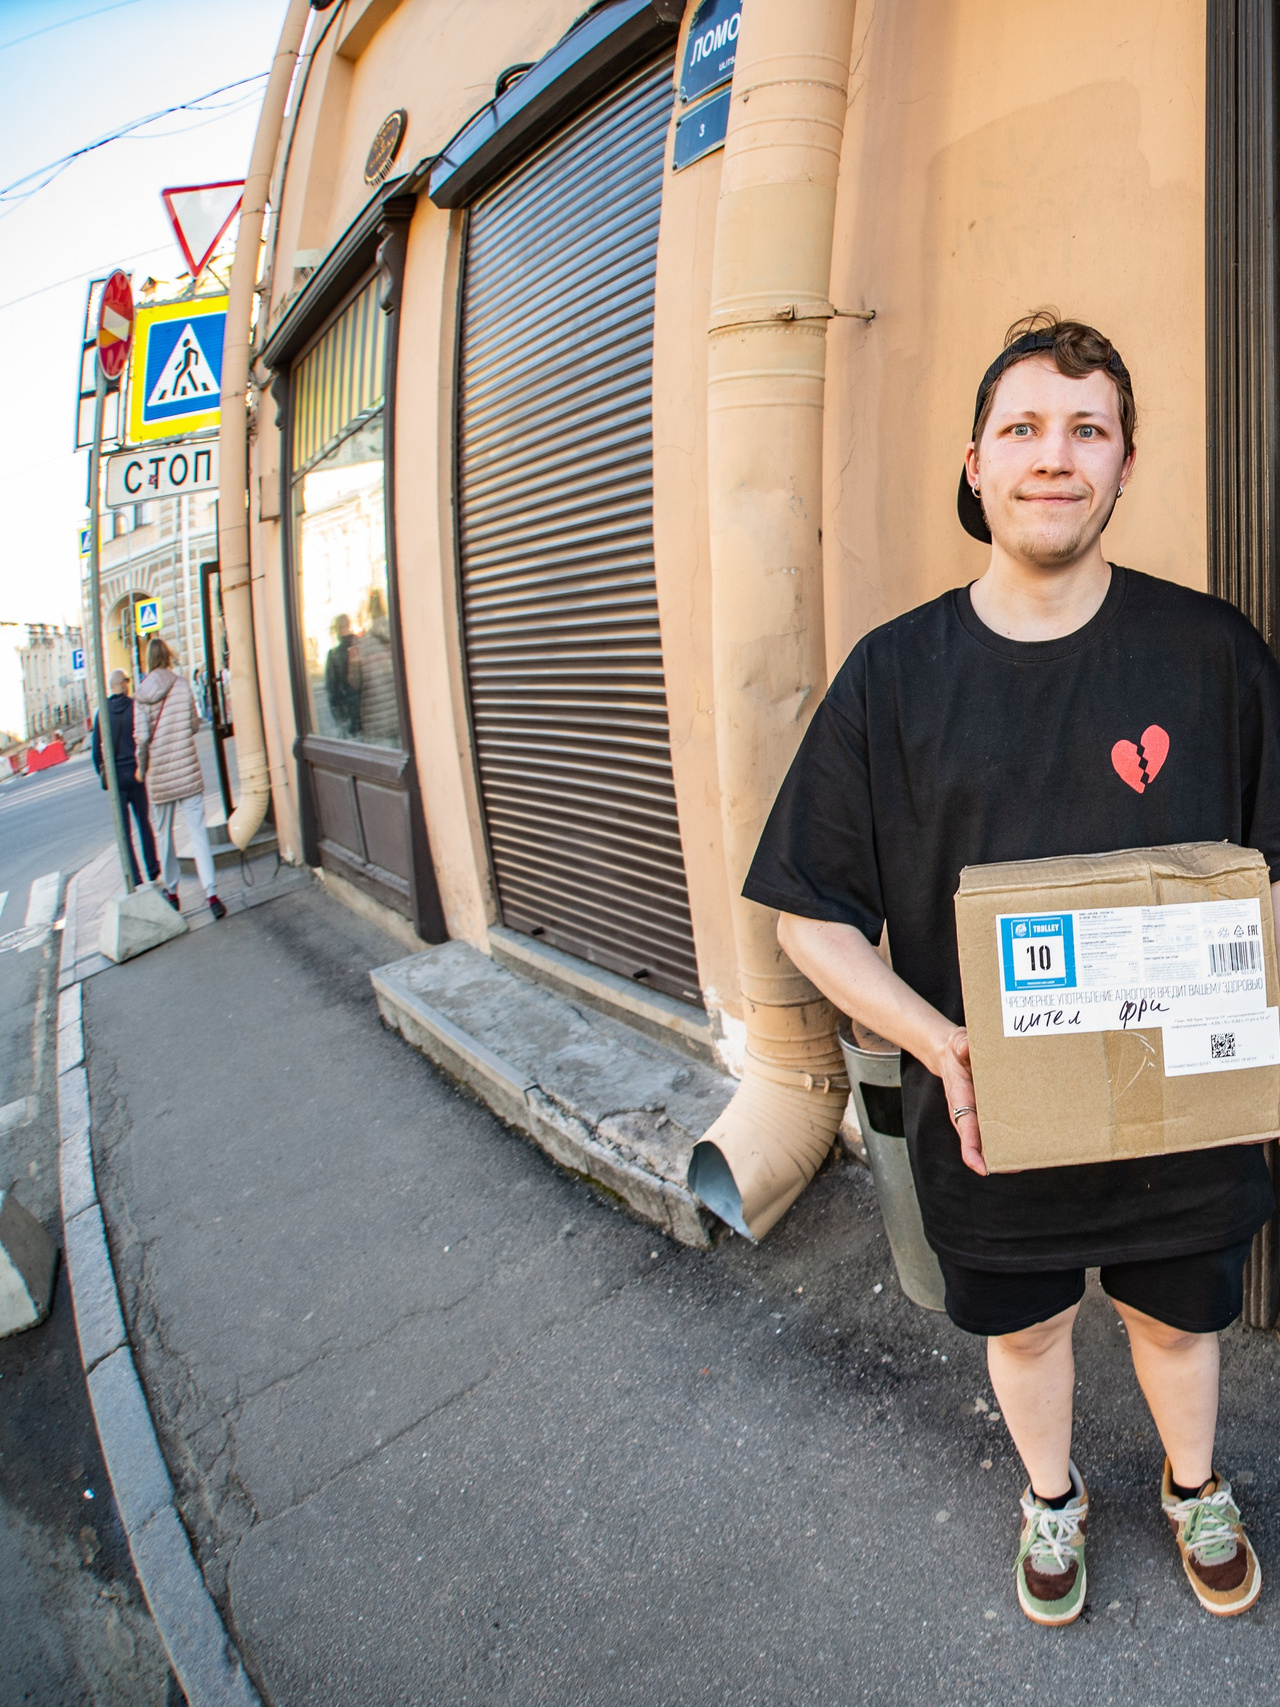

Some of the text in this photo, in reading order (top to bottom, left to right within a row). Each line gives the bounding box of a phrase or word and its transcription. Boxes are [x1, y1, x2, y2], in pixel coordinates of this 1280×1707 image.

[699, 123, 706, 138] 3
[124, 449, 212, 494] СТОП
[1032, 923, 1060, 934] TROLLEY
[1026, 944, 1052, 972] 10
[1005, 993, 1055, 1009] ЧРЕЗМЕРНОЕ
[1056, 988, 1114, 1007] УПОТРЕБЛЕНИЕ
[1115, 984, 1156, 1002] АЛКОГОЛЯ
[1157, 983, 1187, 999] ВРЕДИТ
[1222, 977, 1263, 995] ЗДОРОВЬЮ
